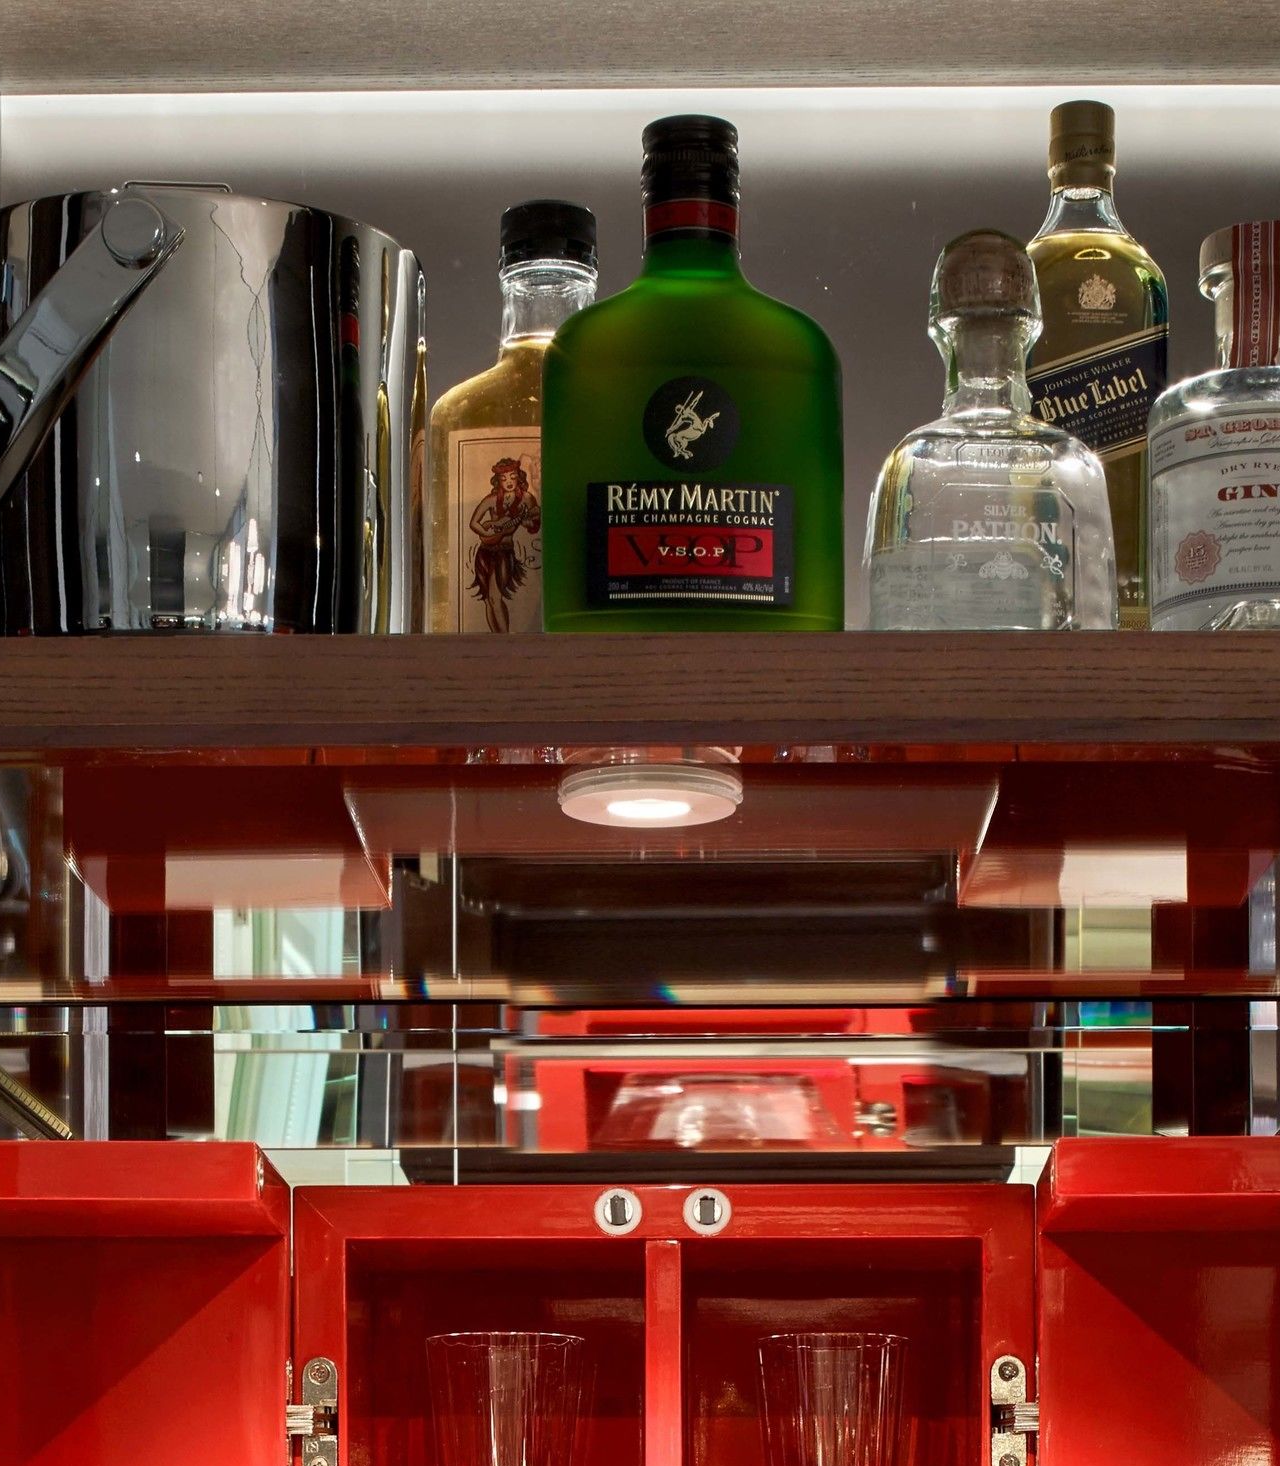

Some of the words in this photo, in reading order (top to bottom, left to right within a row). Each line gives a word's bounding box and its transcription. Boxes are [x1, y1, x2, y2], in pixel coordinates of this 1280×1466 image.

[1251, 275, 1261, 344] GEORGE
[1044, 373, 1090, 394] JOHNNIE
[1091, 357, 1132, 376] WALKER
[1035, 392, 1089, 422] Blue
[1086, 367, 1148, 409] Label
[1088, 405, 1117, 420] SCOTCH
[1120, 396, 1149, 410] WHISKY
[1184, 425, 1217, 441] ST.
[1221, 462, 1247, 475] DRY
[1254, 462, 1280, 472] RYE
[608, 484, 674, 511] RÉMY
[680, 484, 774, 513] MARTIN
[608, 514, 636, 524] FINE
[643, 514, 719, 523] CHAMPAGNE
[726, 515, 775, 526] COGNAC
[983, 505, 1027, 517] SILVER
